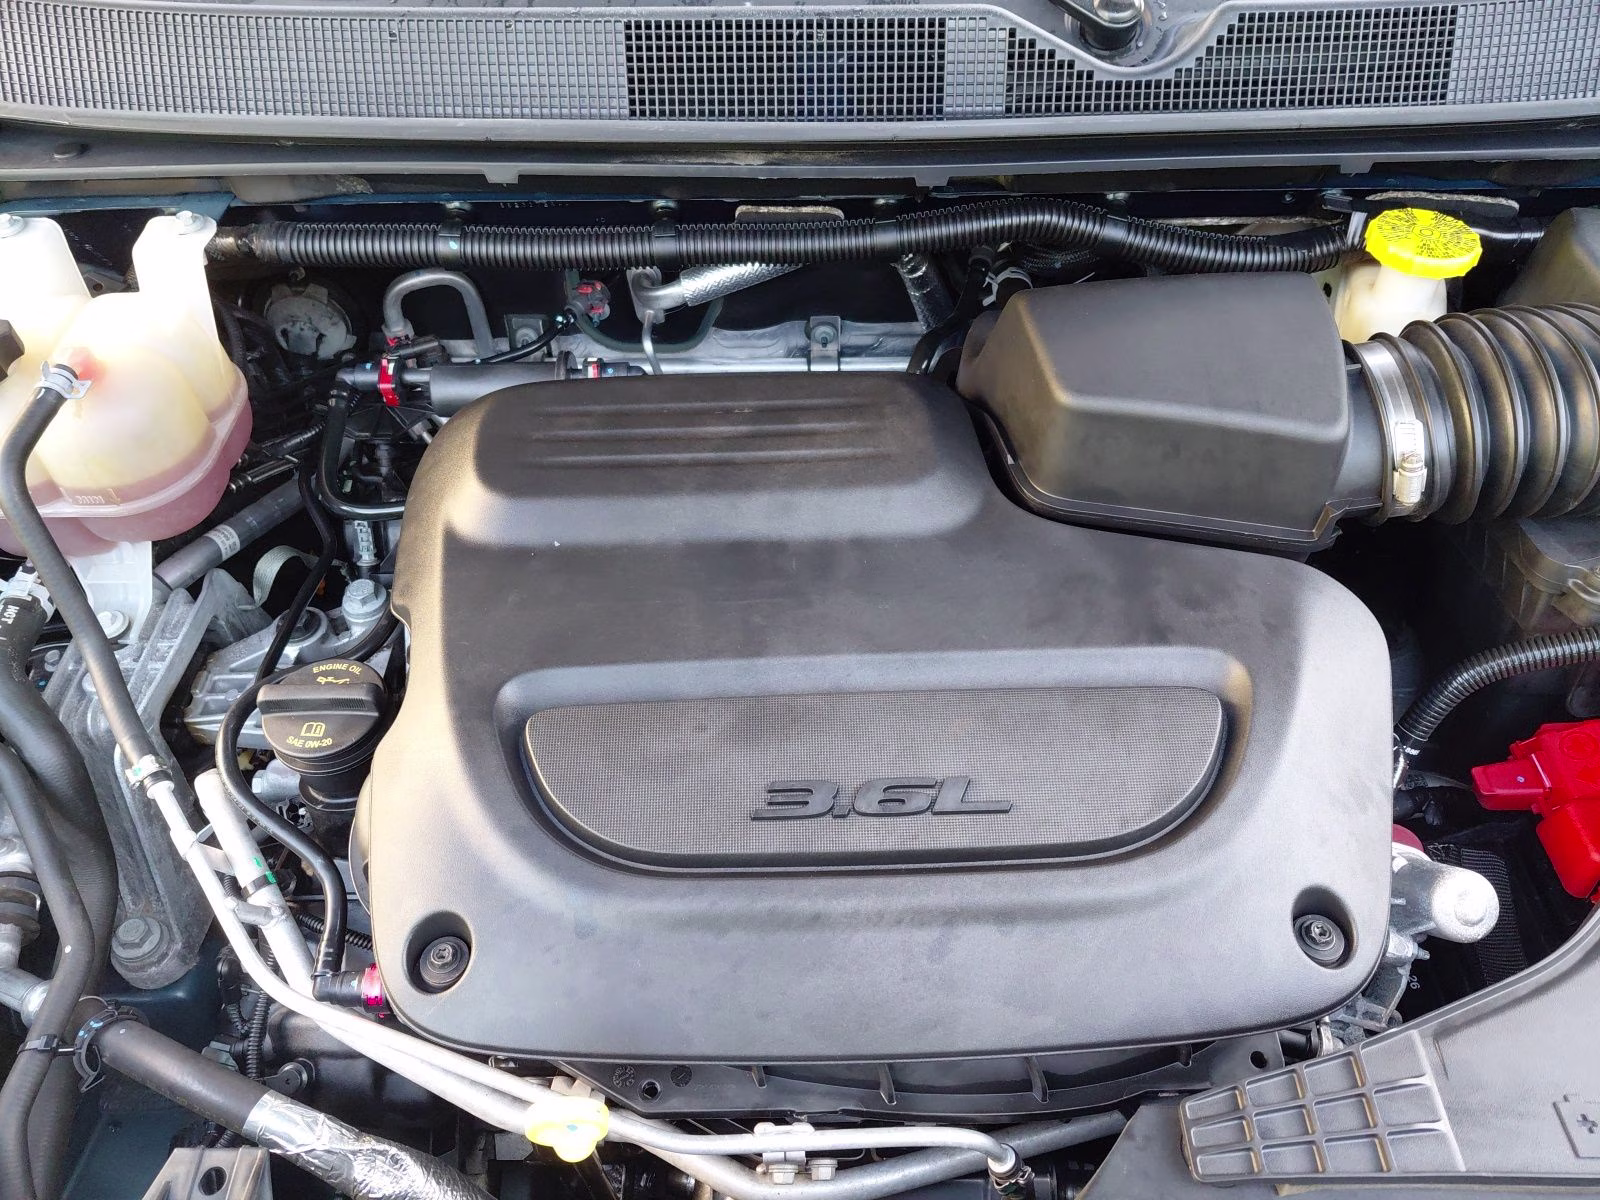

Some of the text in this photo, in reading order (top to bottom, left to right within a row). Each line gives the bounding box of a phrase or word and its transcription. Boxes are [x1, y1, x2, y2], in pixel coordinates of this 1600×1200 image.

[1, 604, 20, 625] HOT
[312, 663, 362, 675] ENGINE OIL
[286, 735, 333, 748] SAE 0W-20
[751, 775, 1012, 820] 3.6L
